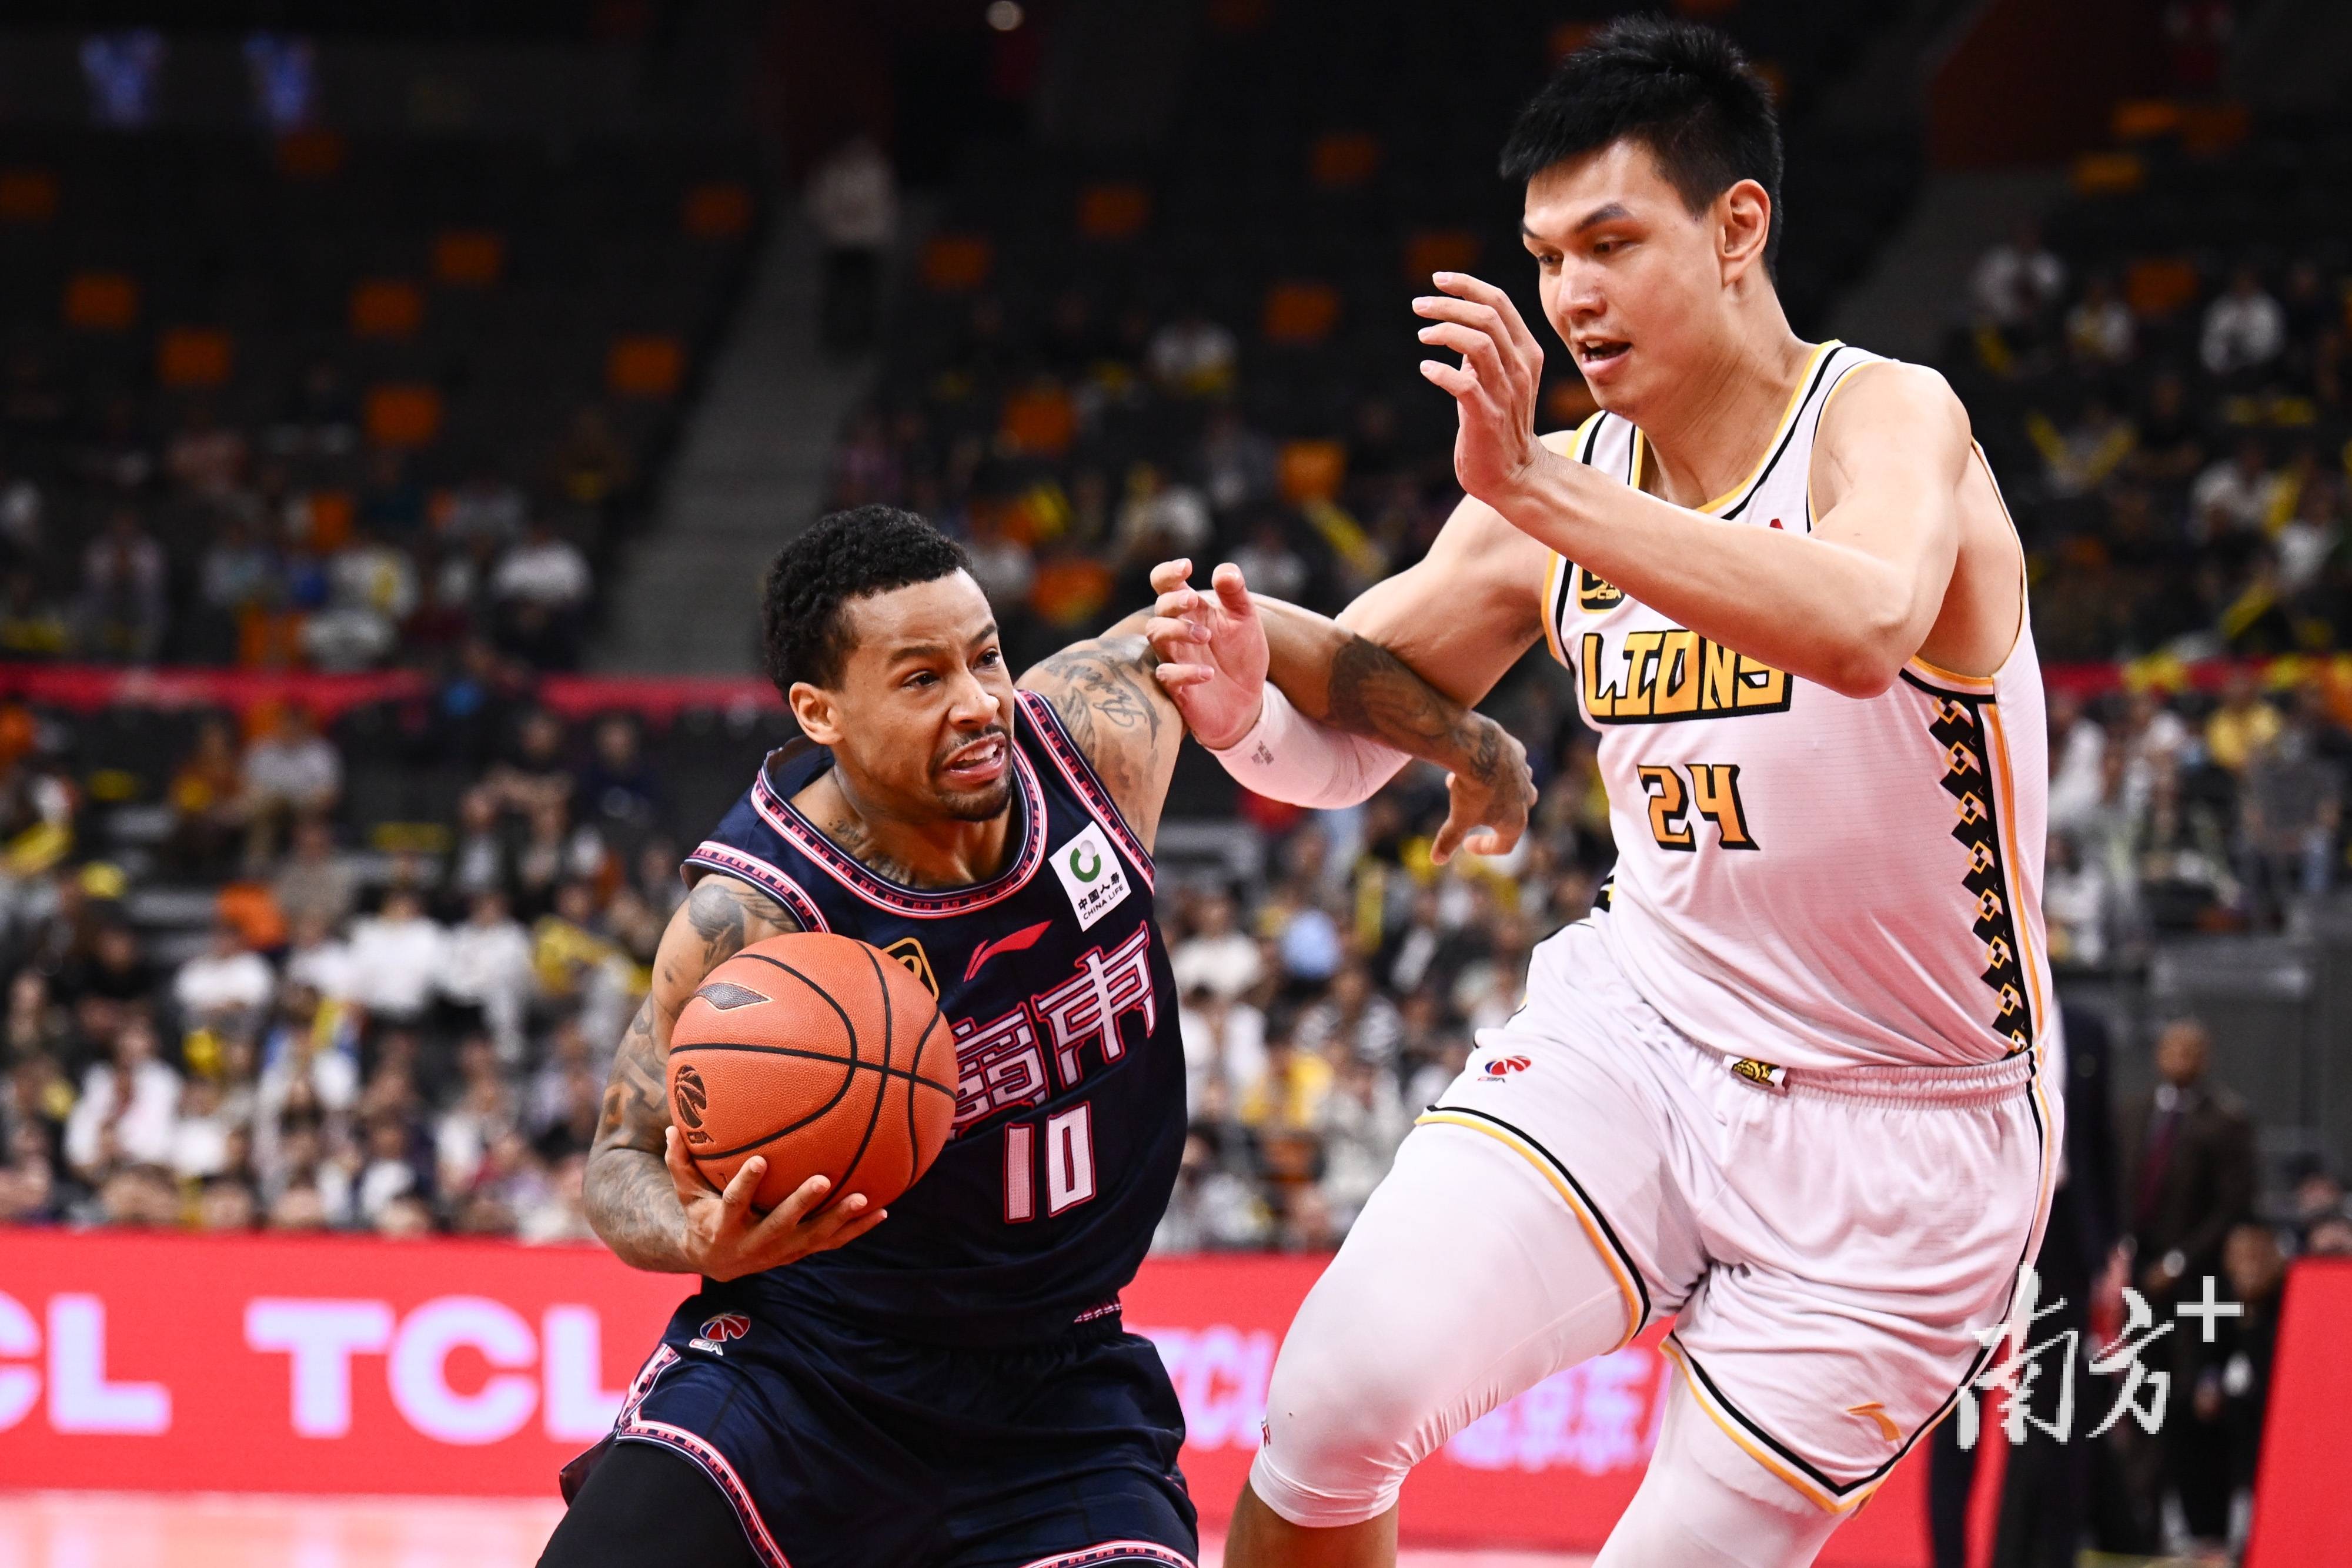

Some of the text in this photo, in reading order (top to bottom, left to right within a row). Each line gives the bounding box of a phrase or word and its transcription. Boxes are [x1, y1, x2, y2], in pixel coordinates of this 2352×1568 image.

[1597, 588, 1621, 600] CBA
[1582, 629, 1794, 725] LIONS
[1637, 764, 1760, 851] 24
[1083, 884, 1124, 920] CHINA LIFE
[1004, 1101, 1096, 1224] 10
[243, 1293, 629, 1446] TCL
[689, 1338, 723, 1356] CBA
